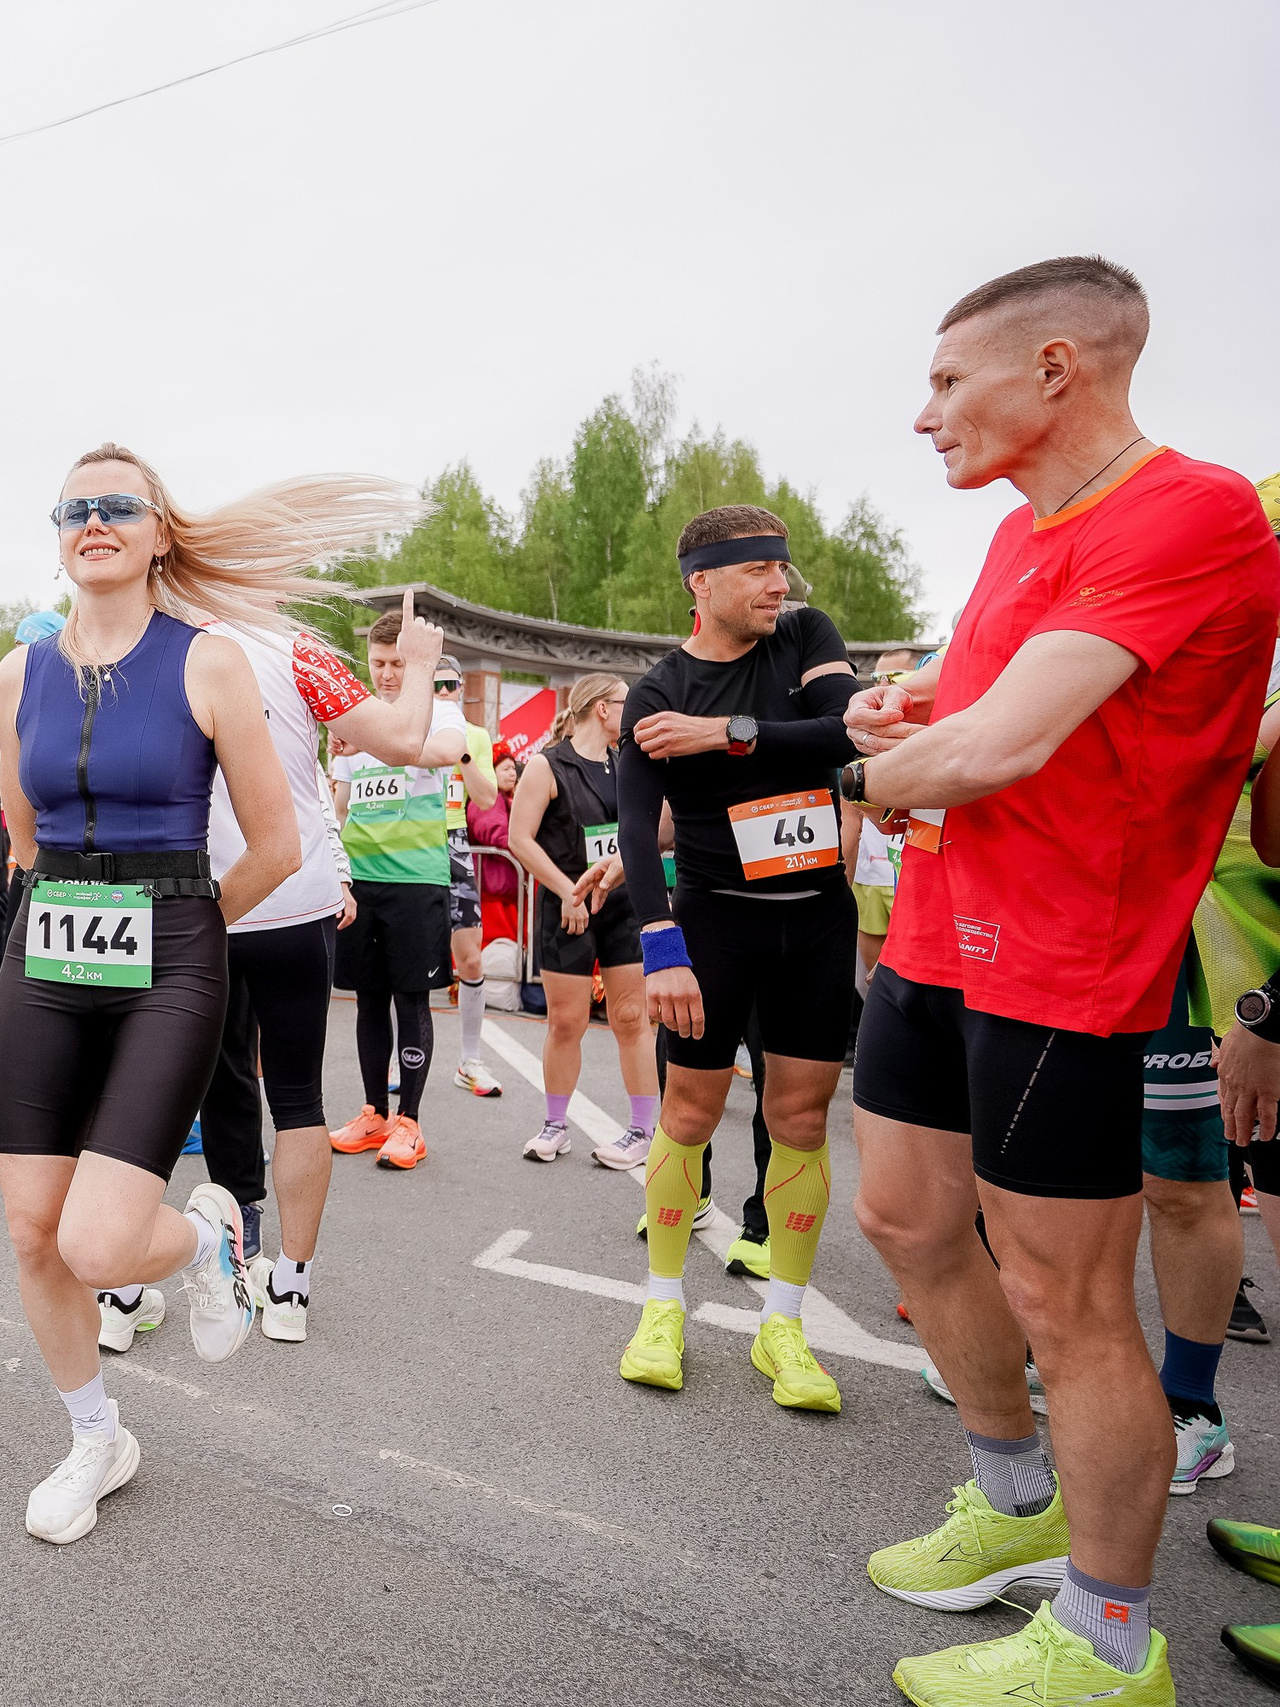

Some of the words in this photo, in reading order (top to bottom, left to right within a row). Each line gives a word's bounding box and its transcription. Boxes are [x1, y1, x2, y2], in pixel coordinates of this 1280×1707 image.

[356, 779, 398, 798] 1666
[773, 815, 814, 847] 46
[38, 912, 138, 956] 1144
